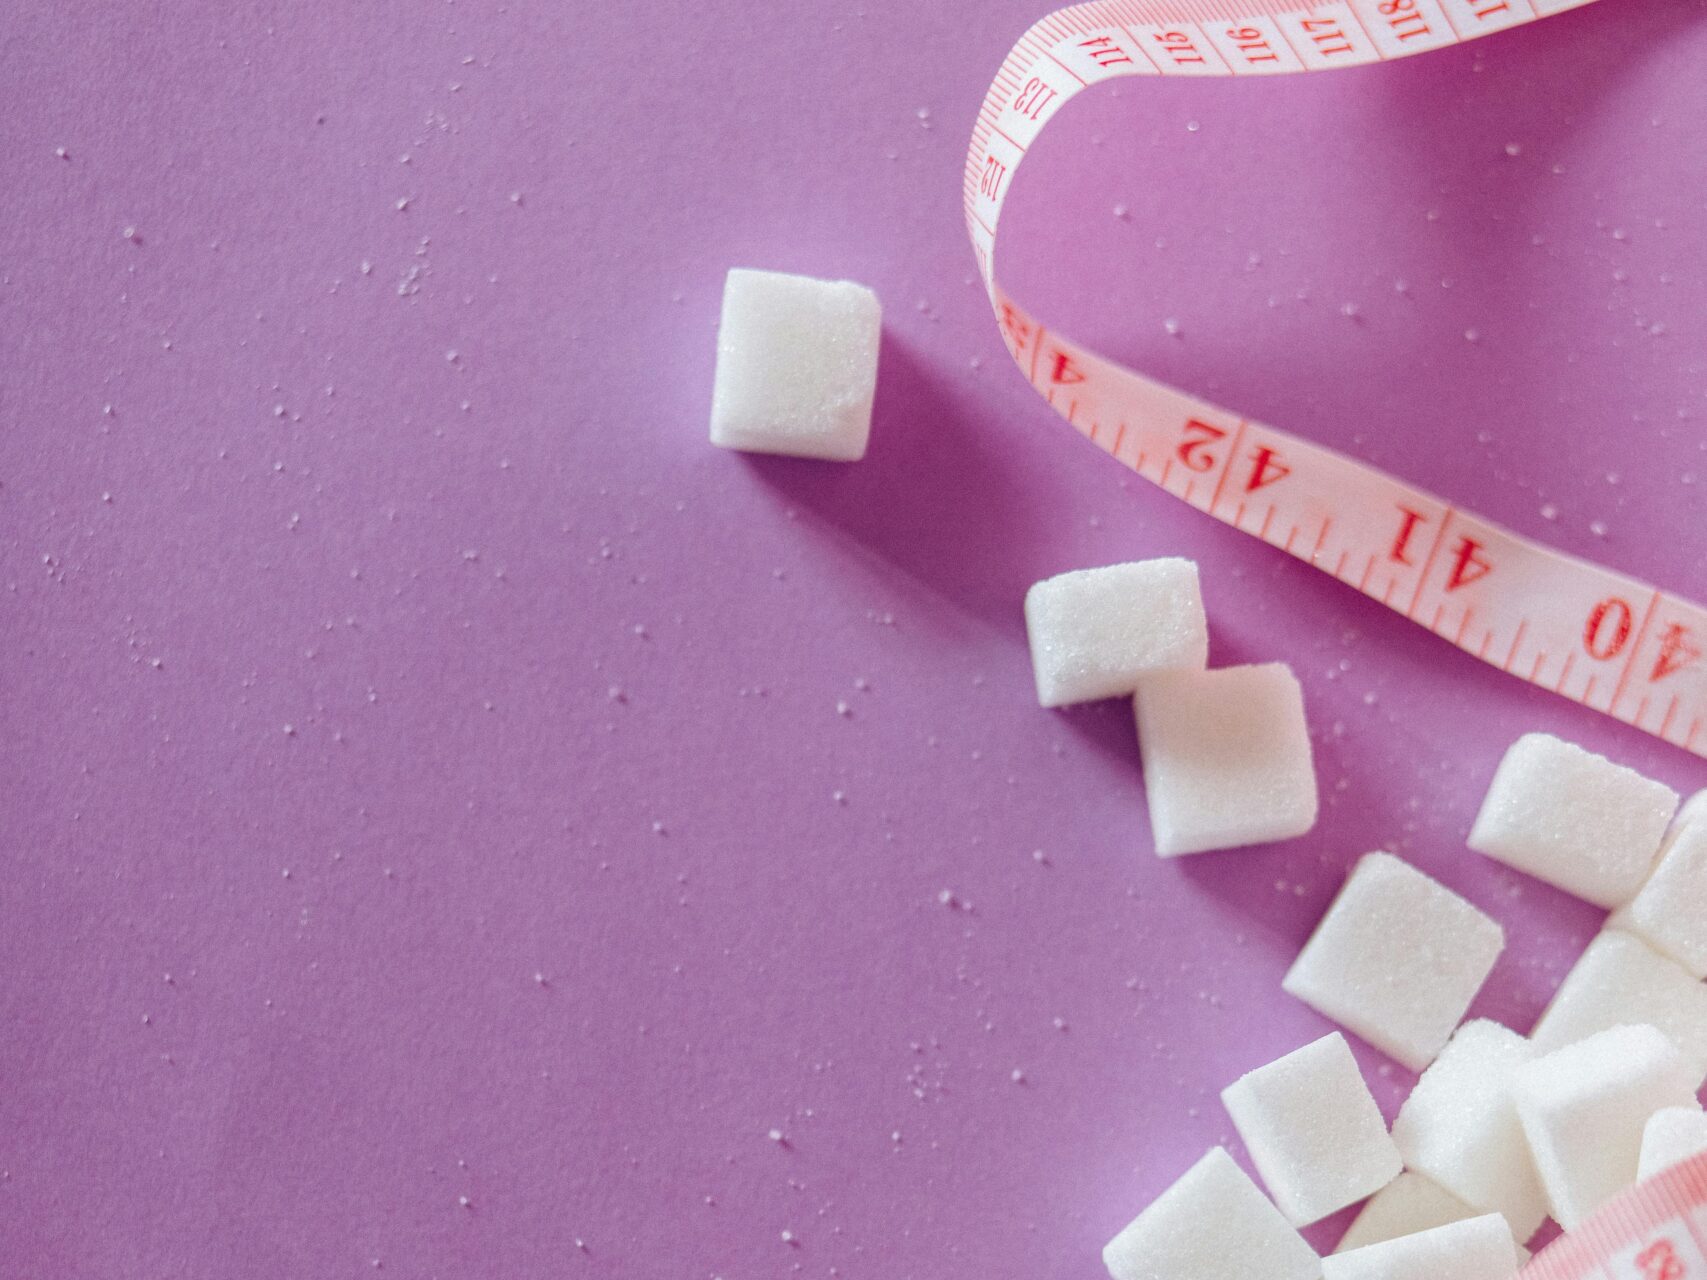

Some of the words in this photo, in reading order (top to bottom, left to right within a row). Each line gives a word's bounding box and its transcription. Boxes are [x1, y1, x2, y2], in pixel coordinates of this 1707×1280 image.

[1013, 77, 1057, 120] 113
[1077, 36, 1133, 67] 114
[1154, 31, 1206, 65] 115
[1227, 27, 1279, 64] 116
[1301, 18, 1354, 56] 117
[1378, 0, 1431, 41] 118
